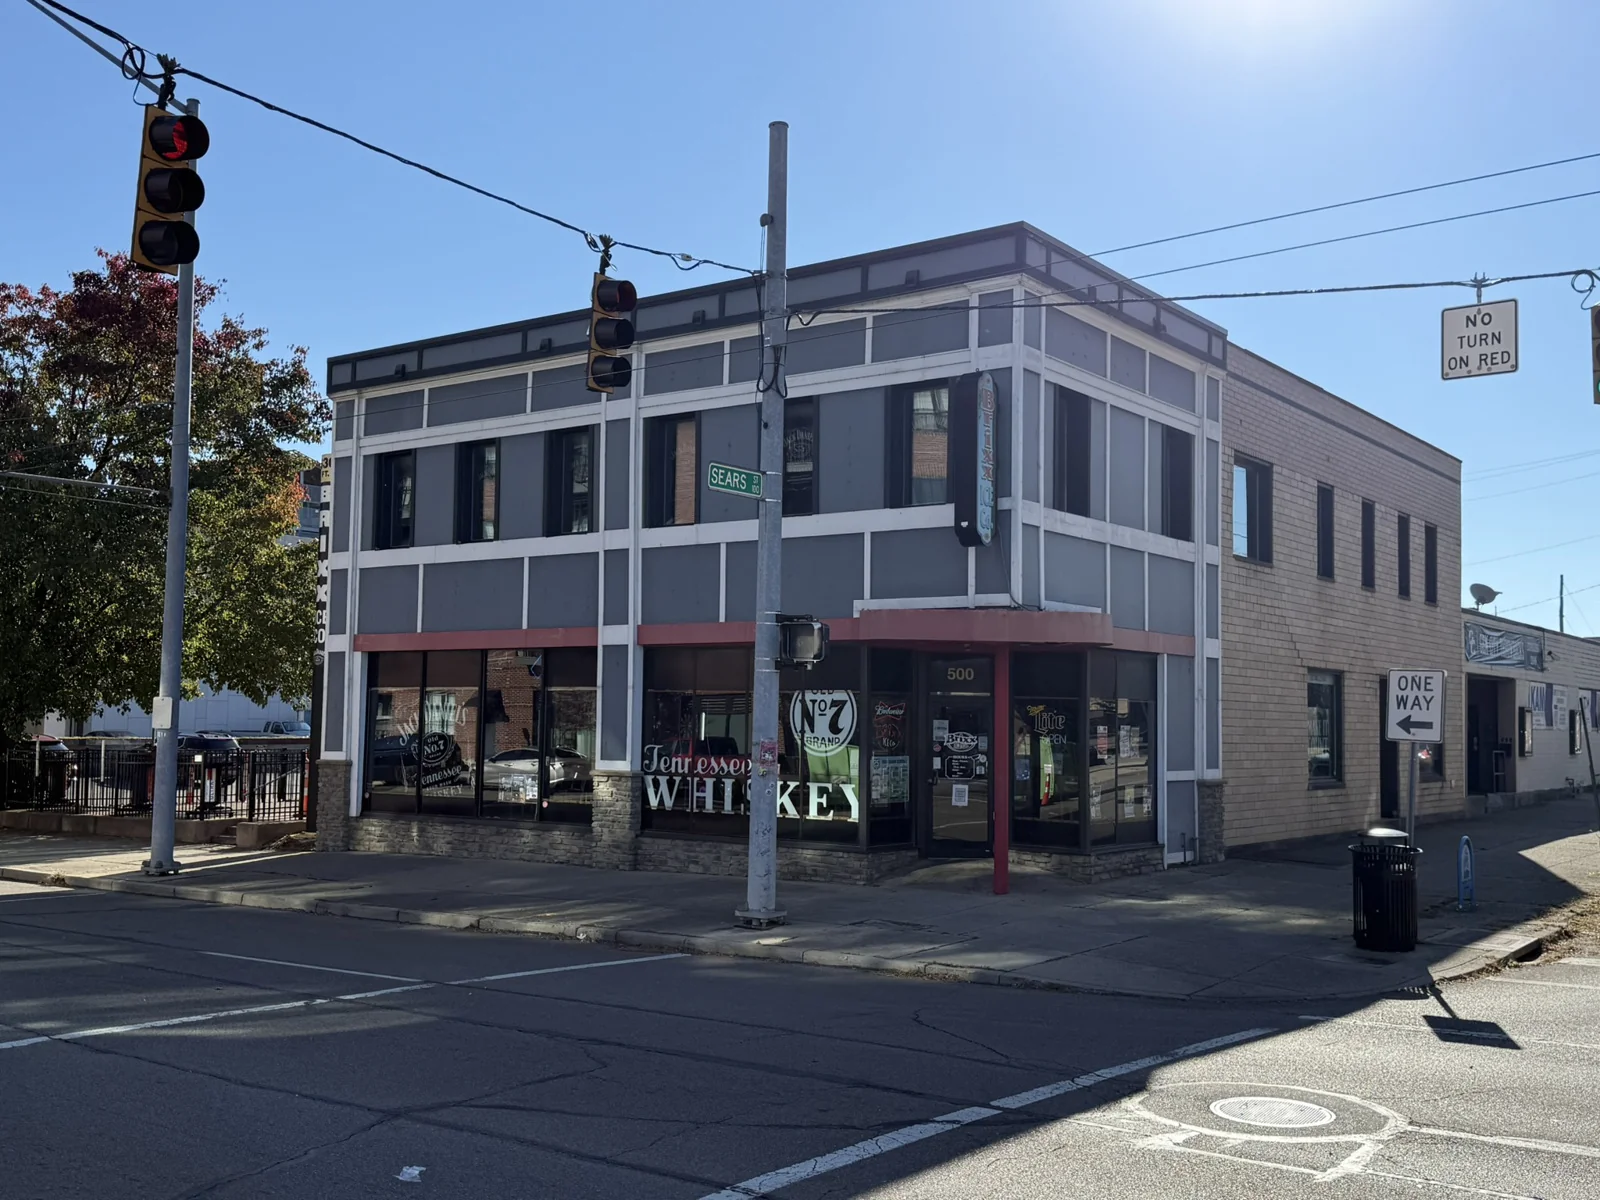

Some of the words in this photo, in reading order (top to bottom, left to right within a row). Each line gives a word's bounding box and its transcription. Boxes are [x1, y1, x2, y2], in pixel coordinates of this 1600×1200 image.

[1465, 312, 1493, 329] NO
[1457, 331, 1502, 349] TURN
[1448, 355, 1469, 371] ON
[1479, 350, 1511, 367] RED
[711, 467, 747, 490] SEARS
[753, 475, 759, 484] ST
[947, 667, 974, 680] 500
[1397, 675, 1434, 692] ONE
[1395, 694, 1435, 711] WAY
[945, 733, 978, 745] Brixx
[421, 765, 462, 785] ennessee
[643, 775, 859, 823] WHIKEY
